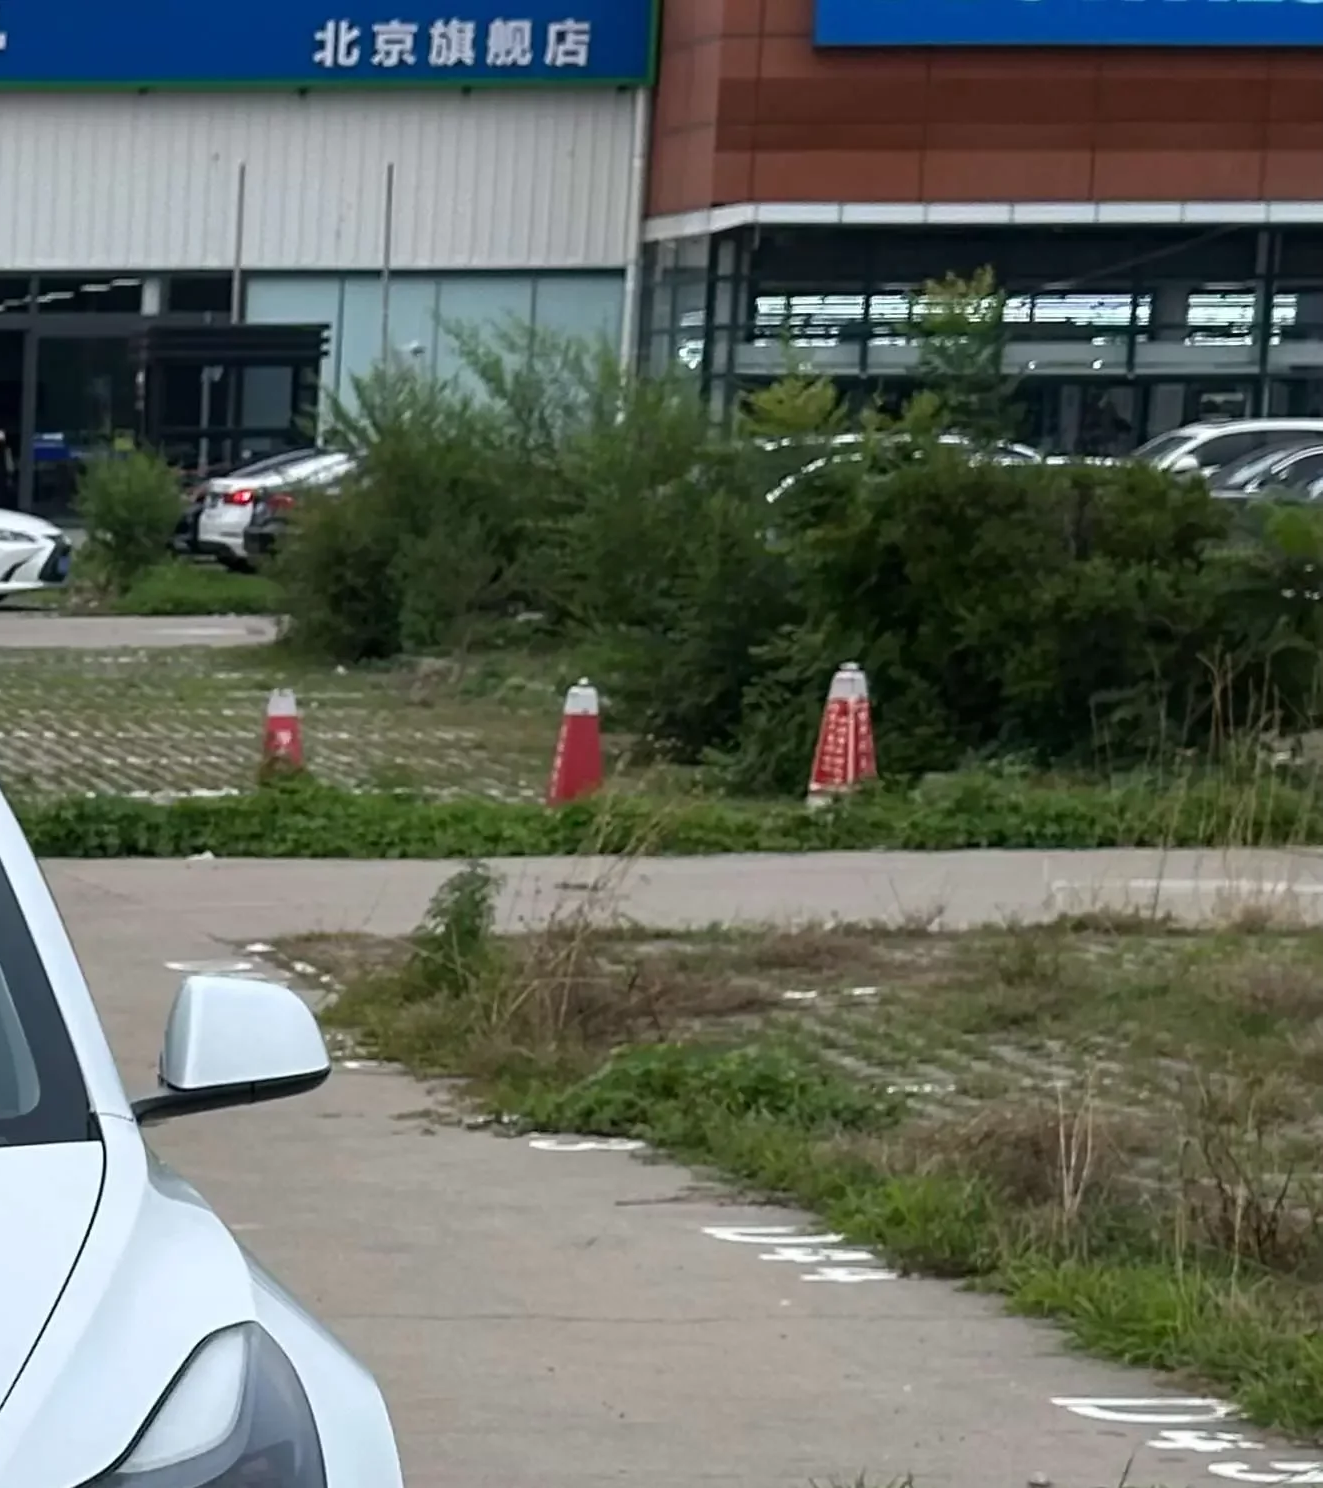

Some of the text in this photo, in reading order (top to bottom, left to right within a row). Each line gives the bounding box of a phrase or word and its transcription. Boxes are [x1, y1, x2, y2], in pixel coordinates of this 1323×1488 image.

[312, 17, 592, 68] 北京旗舰店
